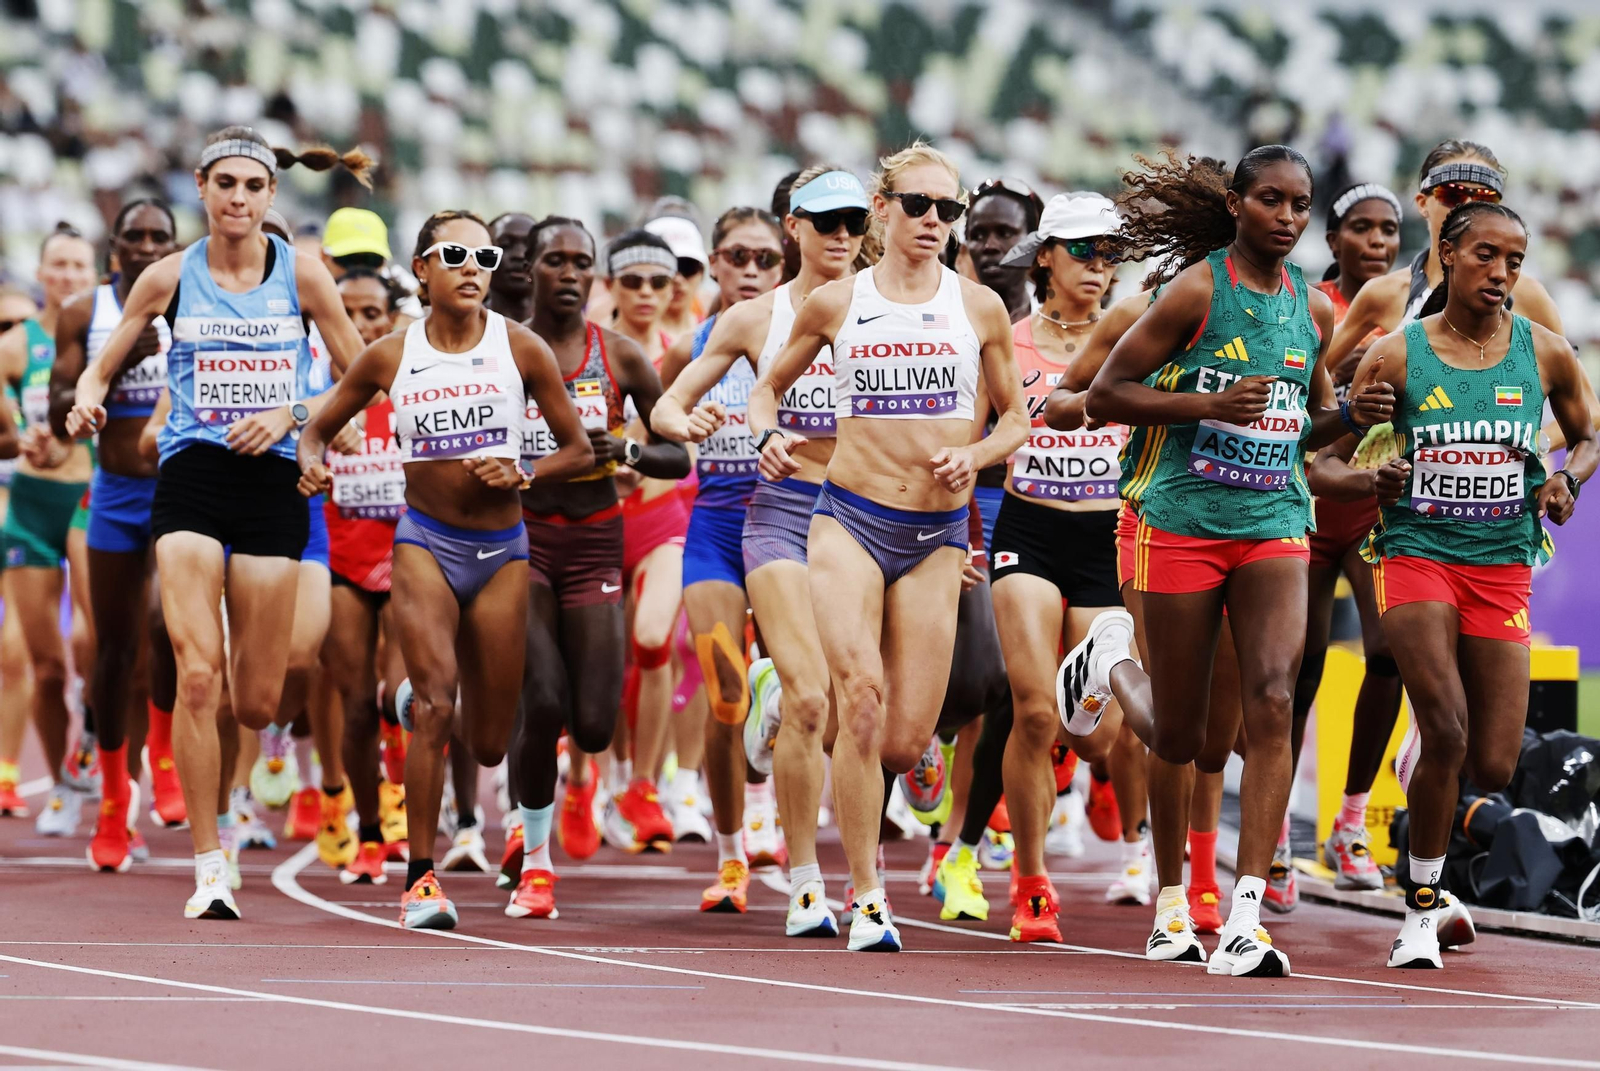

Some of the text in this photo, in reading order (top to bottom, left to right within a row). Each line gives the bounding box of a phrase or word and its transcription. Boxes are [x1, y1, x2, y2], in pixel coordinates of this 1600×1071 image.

[826, 176, 860, 194] USA
[200, 323, 279, 337] URUGUAY
[849, 342, 959, 358] HONDA
[197, 359, 292, 372] HONDA
[854, 366, 955, 392] SULLIVAN
[200, 382, 291, 403] PATERNAIN
[401, 383, 501, 406] HONDA
[414, 405, 494, 435] KEMP
[1412, 420, 1534, 451] ETHIOPIA
[1200, 432, 1290, 467] ASSEFA
[1417, 449, 1523, 465] HONDA
[1025, 455, 1110, 477] ANDO
[1420, 472, 1518, 499] KEBEDE
